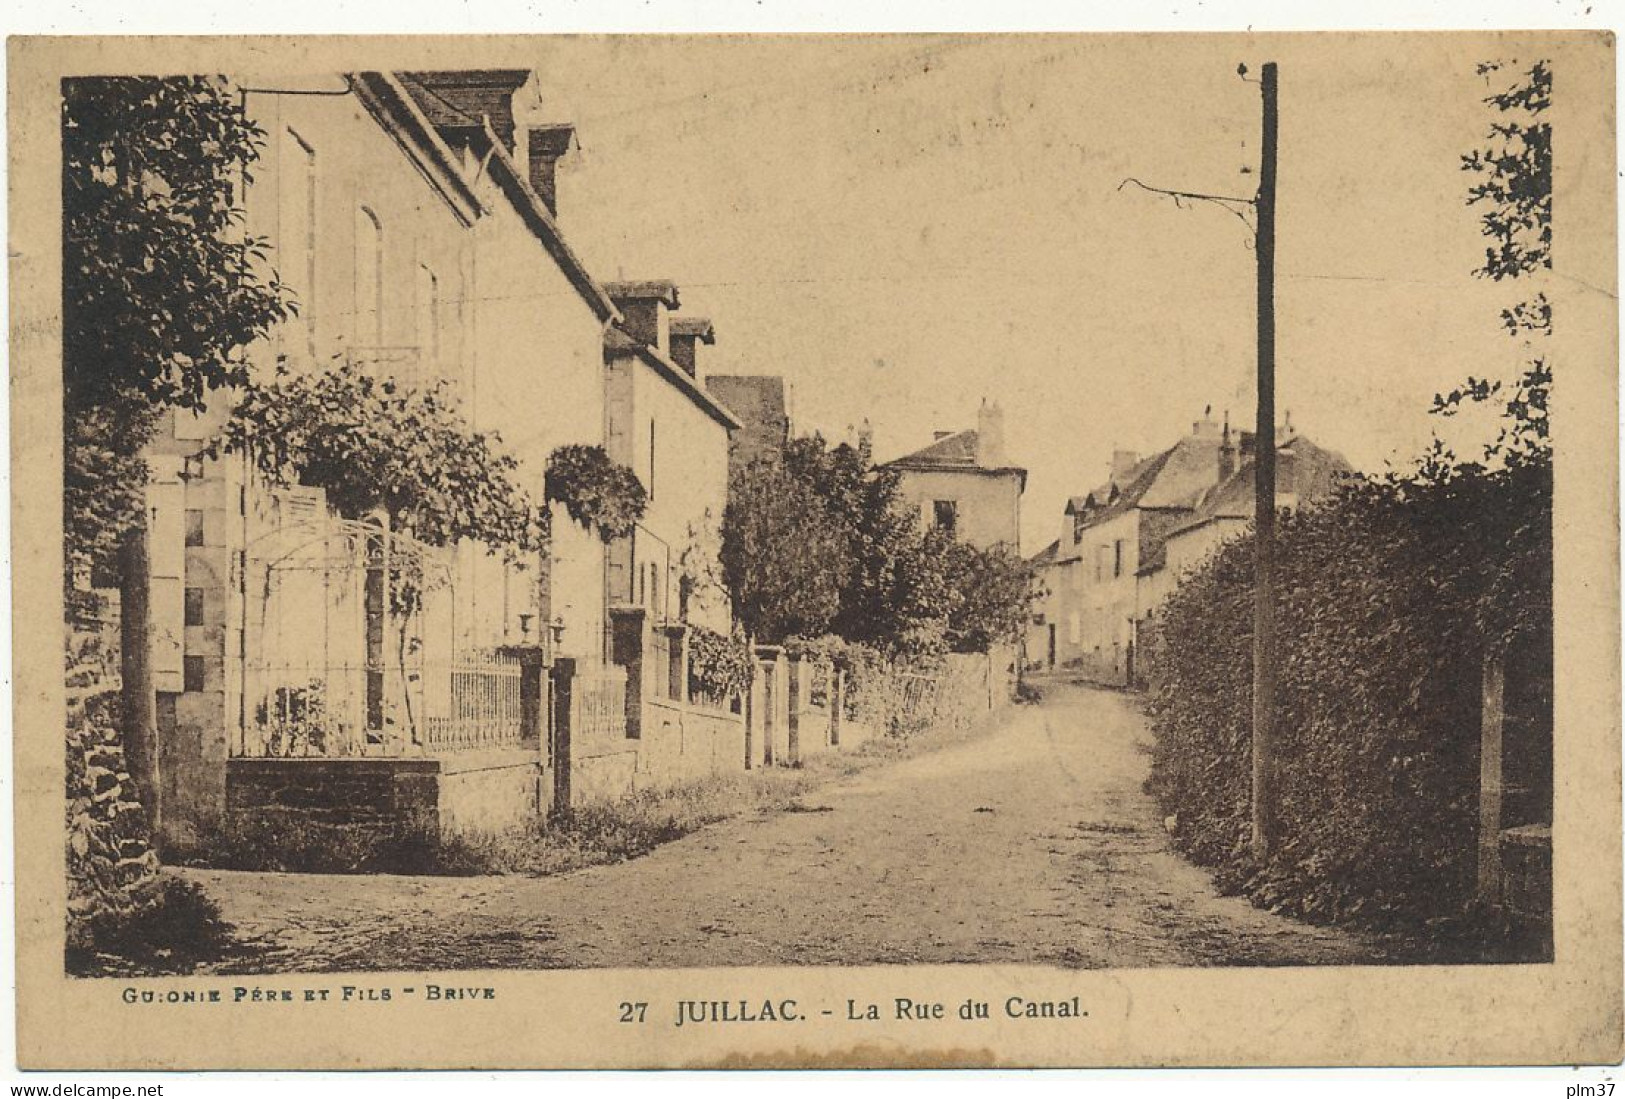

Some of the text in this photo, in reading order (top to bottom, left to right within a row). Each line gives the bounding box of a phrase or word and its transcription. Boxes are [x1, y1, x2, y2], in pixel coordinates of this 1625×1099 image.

[304, 989, 330, 1002] ET
[341, 986, 393, 1002] FILS
[425, 984, 496, 1001] BRIVE
[619, 1002, 649, 1023] 27
[675, 999, 806, 1027] JUILLAC.
[847, 999, 881, 1020] La
[894, 998, 944, 1020] Rue
[958, 998, 990, 1020] du
[1005, 996, 1090, 1019] Canal.
